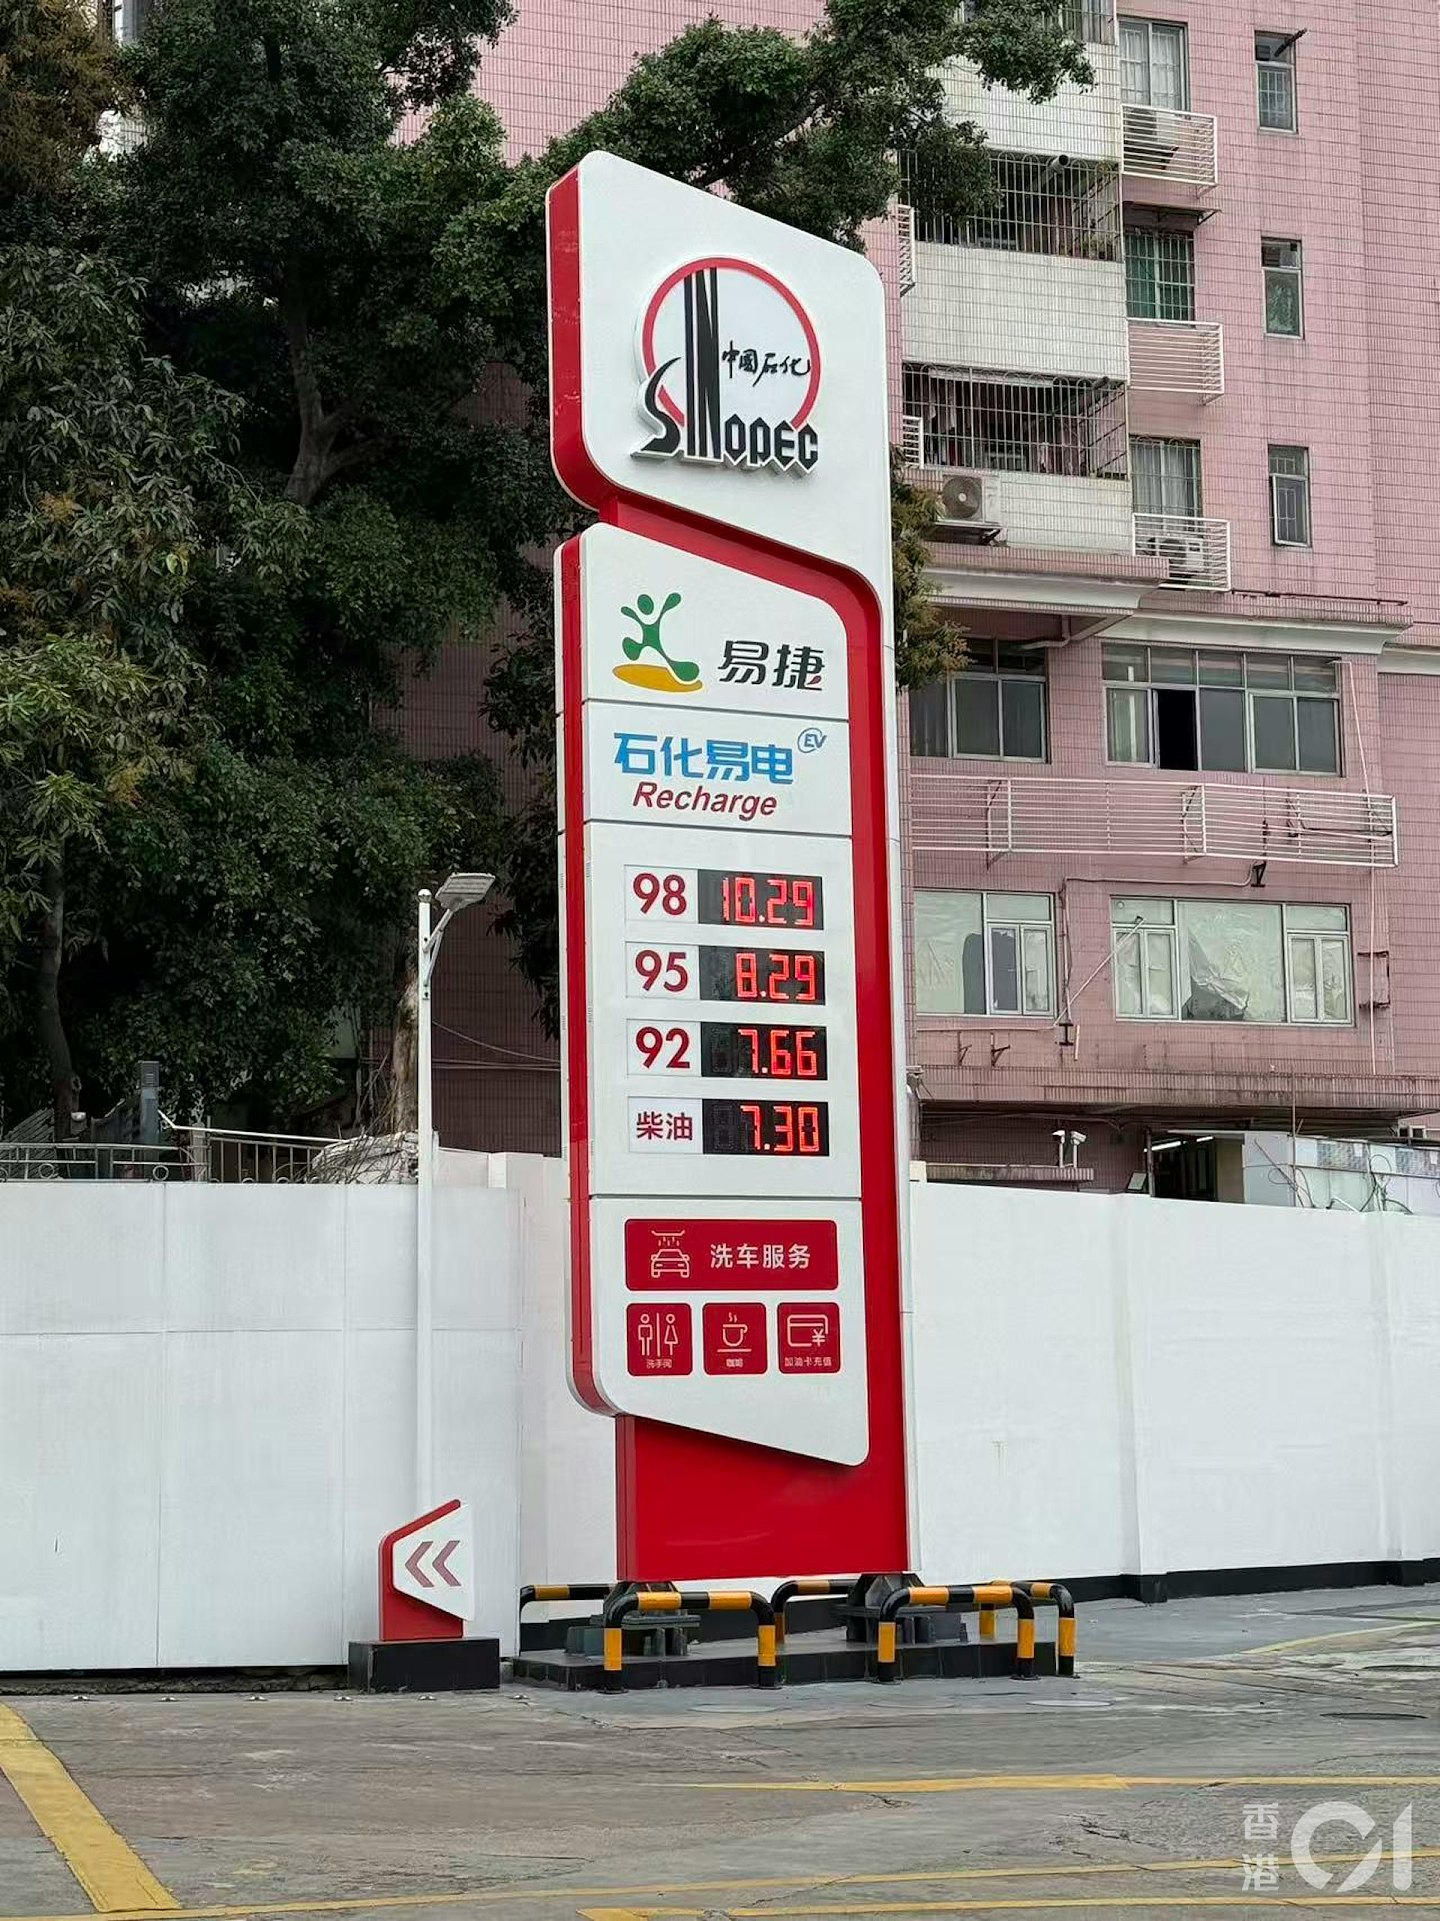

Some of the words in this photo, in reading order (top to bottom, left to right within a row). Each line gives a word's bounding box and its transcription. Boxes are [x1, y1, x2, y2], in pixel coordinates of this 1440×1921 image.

[718, 640, 825, 691] 易捷
[614, 732, 794, 784] 石化易电
[803, 734, 827, 749] EV
[632, 781, 777, 821] Recharge
[633, 873, 687, 915] 98
[722, 877, 813, 926] 10.29
[635, 950, 688, 992] 95
[736, 952, 816, 1000] 8.29
[636, 1026, 690, 1068] 92
[738, 1029, 817, 1076] 7.66
[636, 1111, 693, 1141] 柴油
[740, 1105, 819, 1152] 7.30
[710, 1243, 811, 1269] 洗车服务
